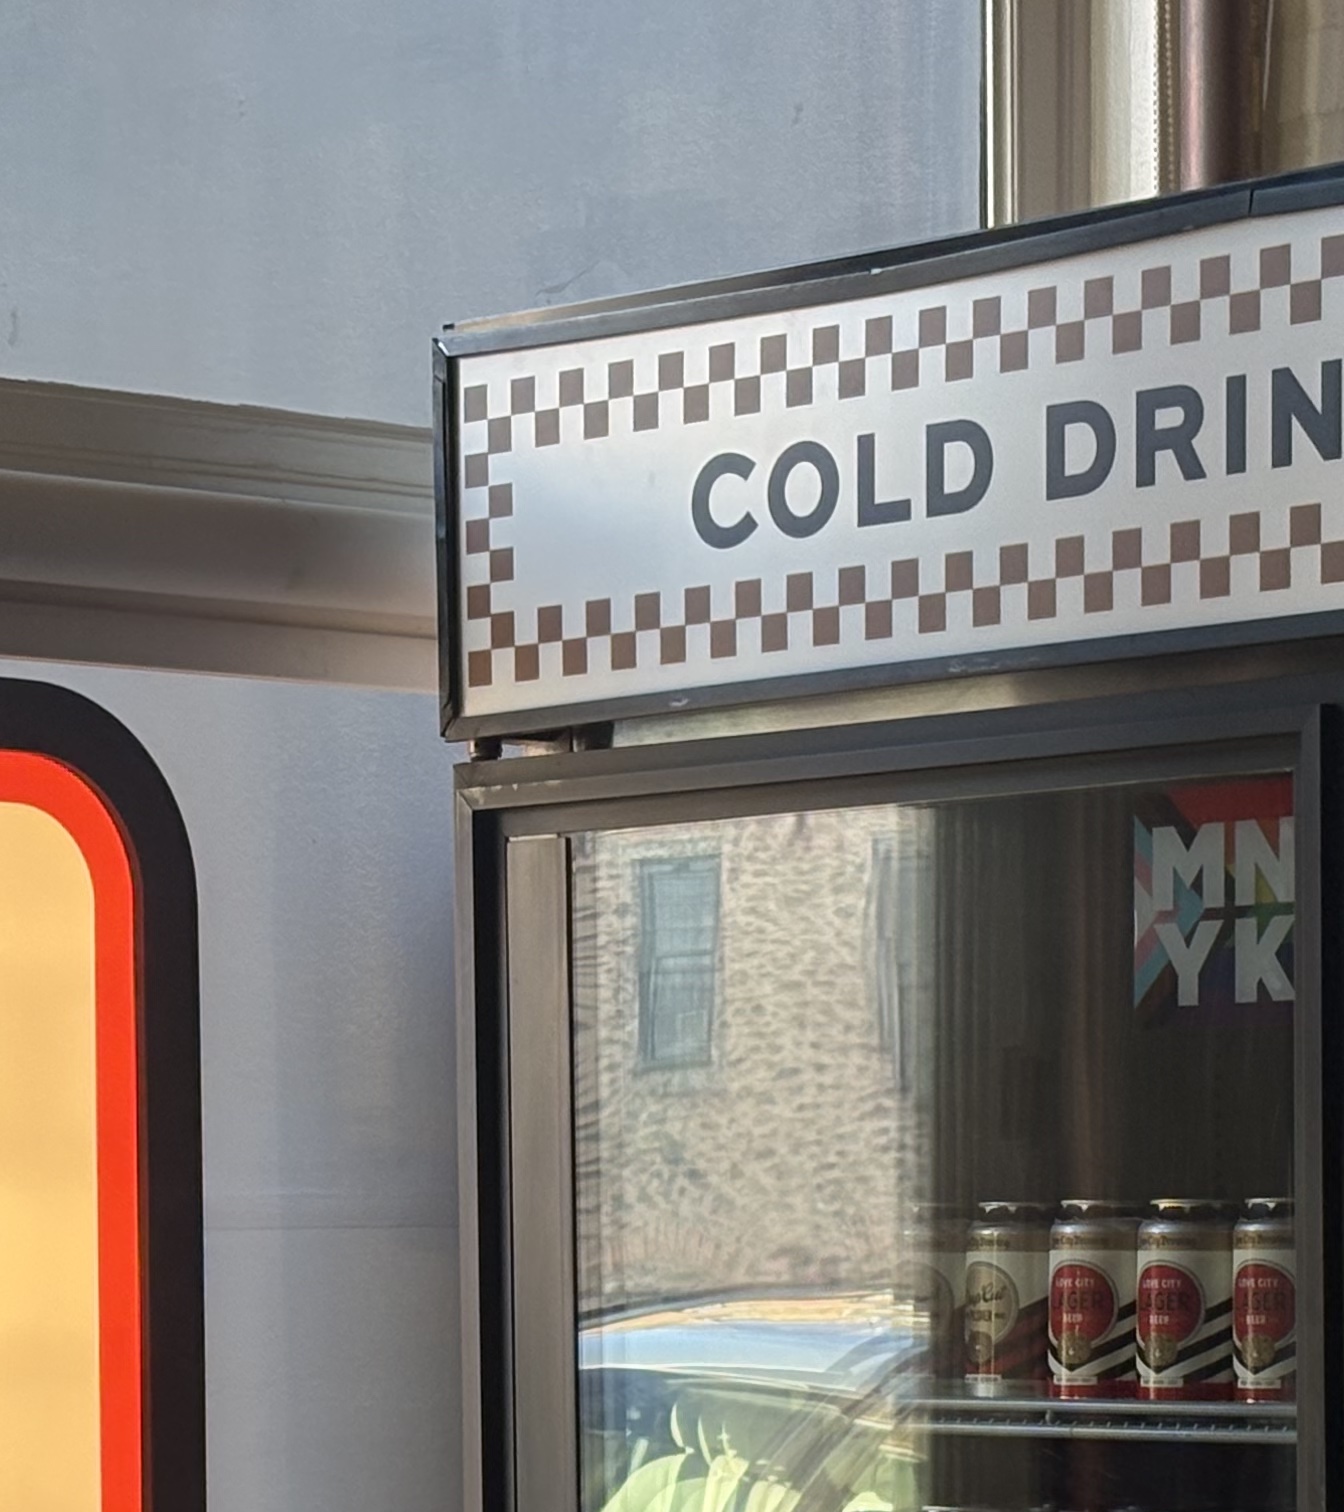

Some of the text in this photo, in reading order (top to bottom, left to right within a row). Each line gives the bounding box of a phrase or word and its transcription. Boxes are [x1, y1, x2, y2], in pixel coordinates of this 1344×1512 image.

[690, 418, 994, 550] COLD
[1152, 815, 1296, 911] MN
[1153, 914, 1296, 1007] YK
